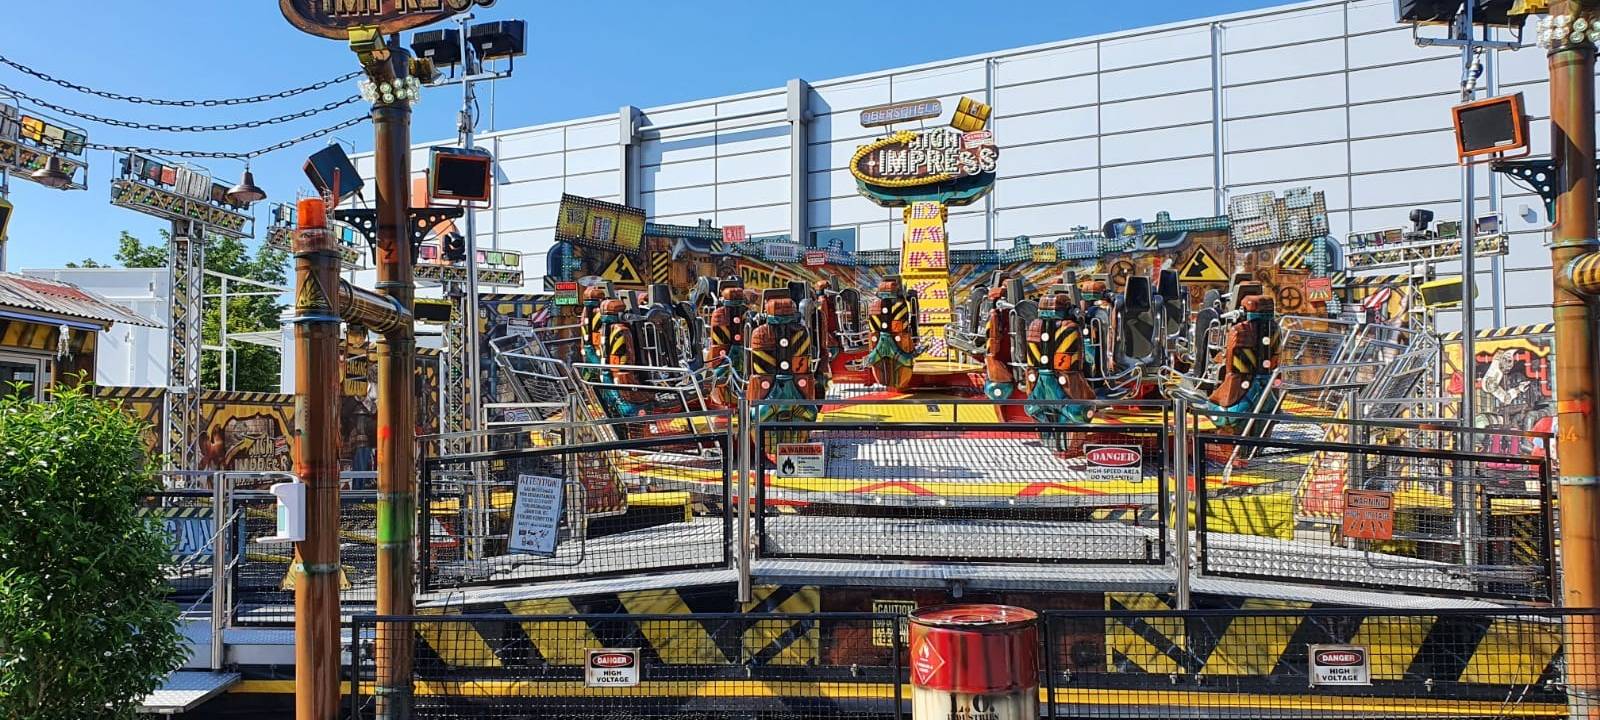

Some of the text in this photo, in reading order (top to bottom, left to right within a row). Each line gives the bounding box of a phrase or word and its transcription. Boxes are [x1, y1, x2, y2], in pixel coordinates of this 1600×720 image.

[879, 146, 999, 176] IMPRESS
[742, 267, 788, 289] DANGE
[1092, 453, 1135, 461] DANGER
[877, 603, 914, 615] CAUTION
